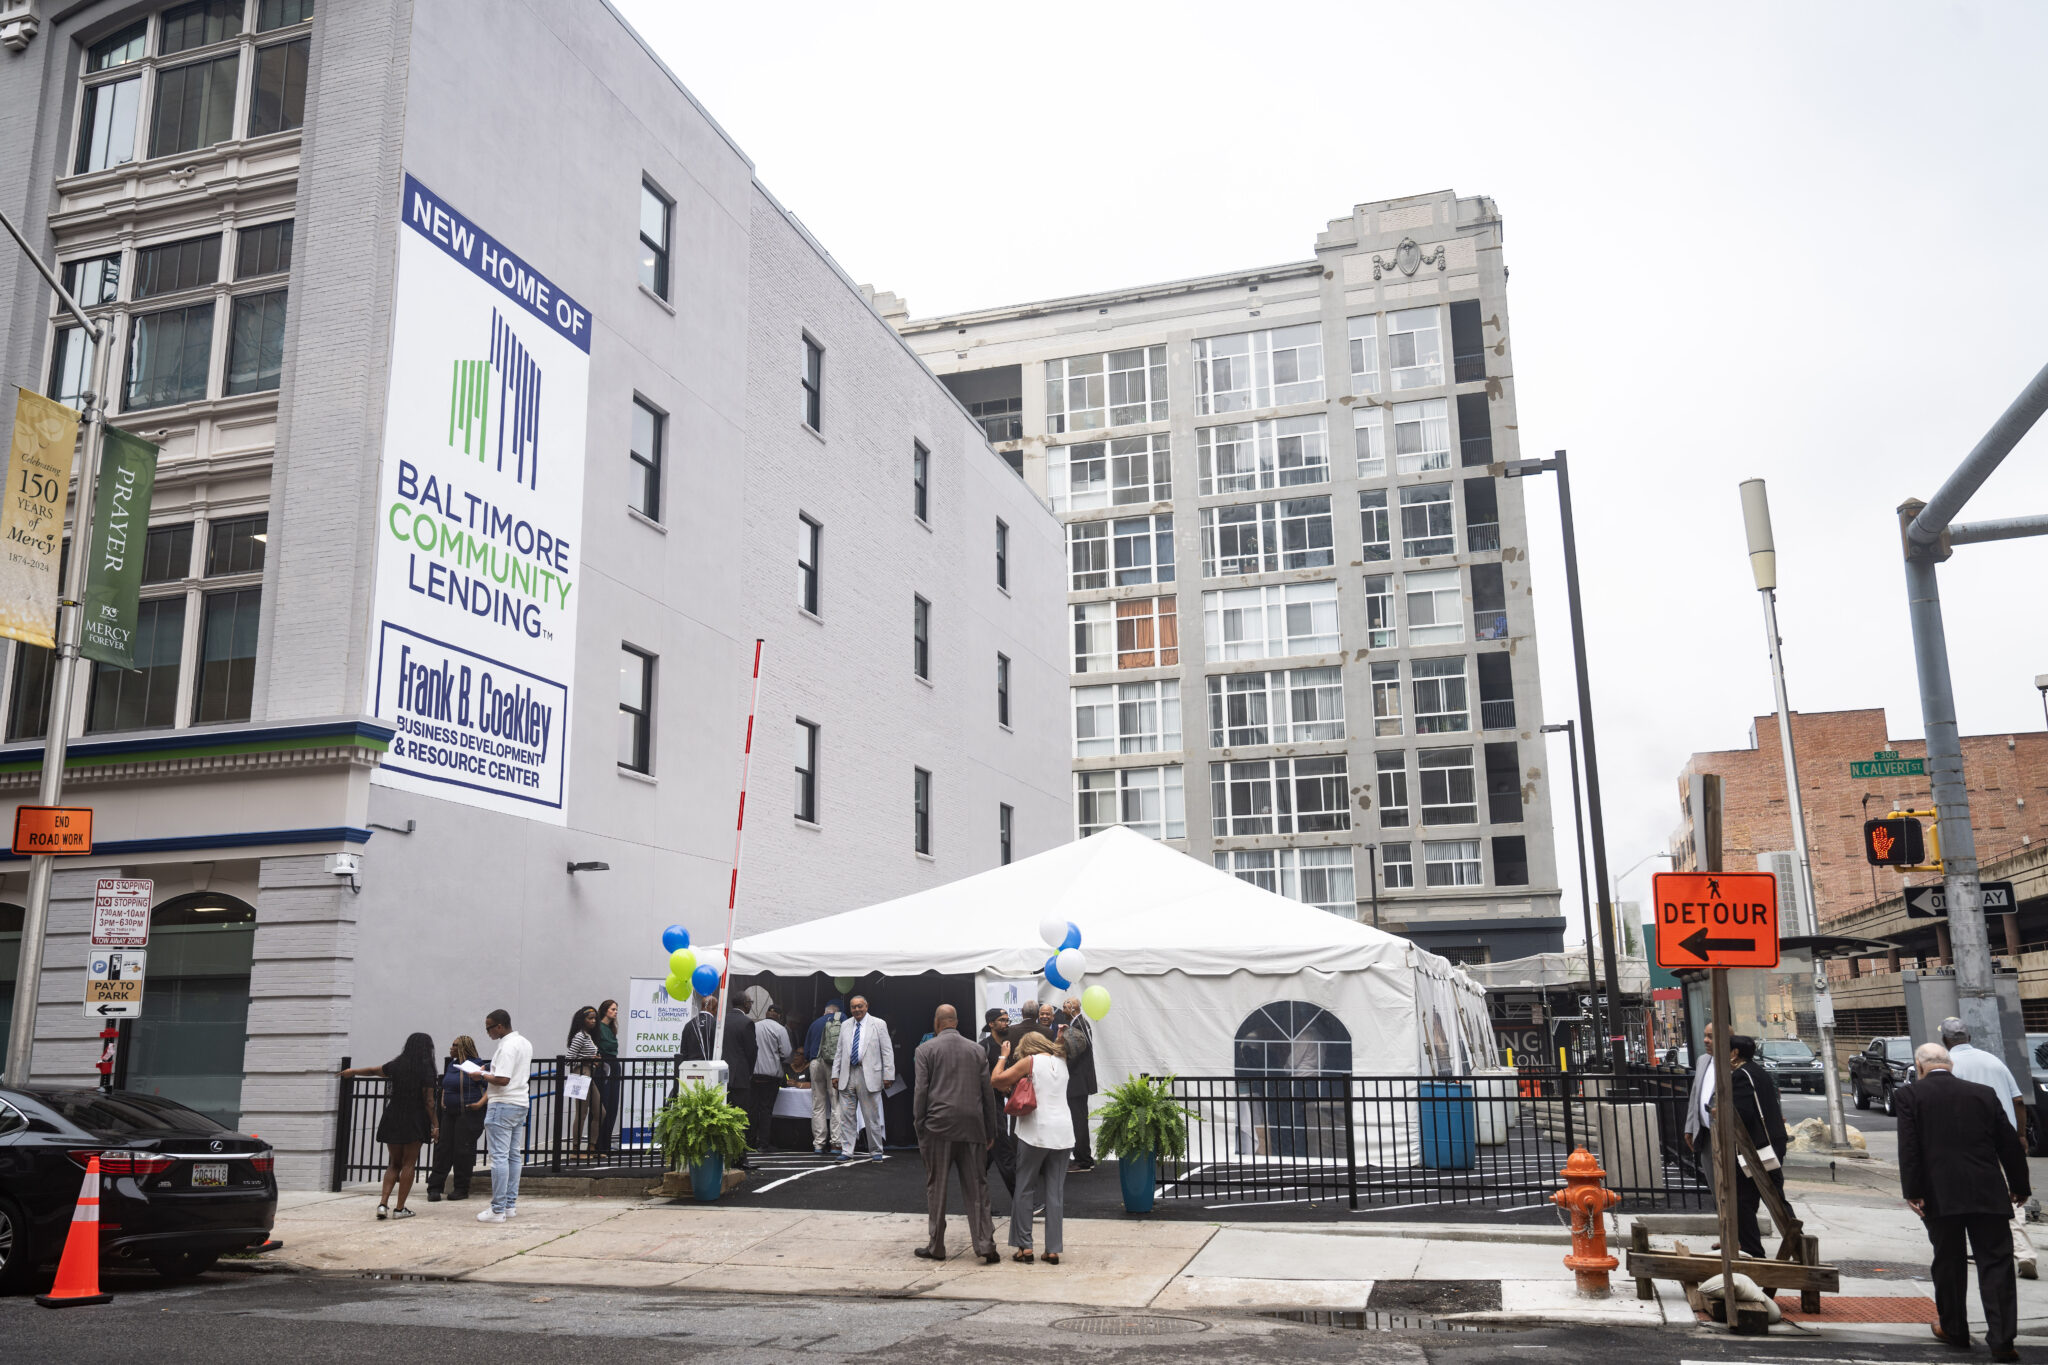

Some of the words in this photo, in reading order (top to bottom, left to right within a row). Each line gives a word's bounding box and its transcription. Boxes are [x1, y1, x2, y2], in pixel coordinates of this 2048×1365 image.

[413, 191, 475, 260] NEW
[481, 241, 550, 316] HOME
[556, 298, 585, 336] OF
[21, 453, 61, 477] Celebrating
[19, 469, 59, 503] 150
[17, 497, 54, 519] YEARS
[104, 465, 135, 571] PRAYER
[397, 458, 570, 574] BALTIMORE
[28, 517, 42, 531] of
[6, 526, 56, 555] Mercy
[9, 552, 49, 572] 1874-2024
[389, 502, 572, 611] COMMUNITY
[409, 553, 541, 639] LENDING
[86, 619, 130, 641] MERCY
[89, 633, 125, 650] FOREVER
[397, 644, 455, 724] Frank
[458, 665, 474, 729] B.
[478, 672, 552, 764] Coakley
[397, 715, 458, 745] BUSINESS
[460, 732, 542, 767] DEVELOPMENT
[394, 737, 405, 757] &
[408, 740, 487, 775] RESOURCE
[488, 761, 540, 789] CENTER
[1880, 751, 1897, 759] 300
[55, 815, 70, 828] END
[29, 833, 60, 845] ROAD
[62, 833, 83, 845] WORK
[100, 880, 113, 889] NO
[116, 881, 149, 890] STOPPING
[97, 897, 111, 906] NO
[114, 898, 148, 907] STOPPING
[1984, 891, 2003, 905] AY
[1664, 902, 1767, 925] DETOUR
[94, 982, 116, 990] PAY
[120, 982, 134, 990] TO
[98, 992, 129, 1000] PARK
[630, 1010, 652, 1018] BCL
[672, 1033, 681, 1041] B.
[635, 1044, 680, 1052] COAKLEY
